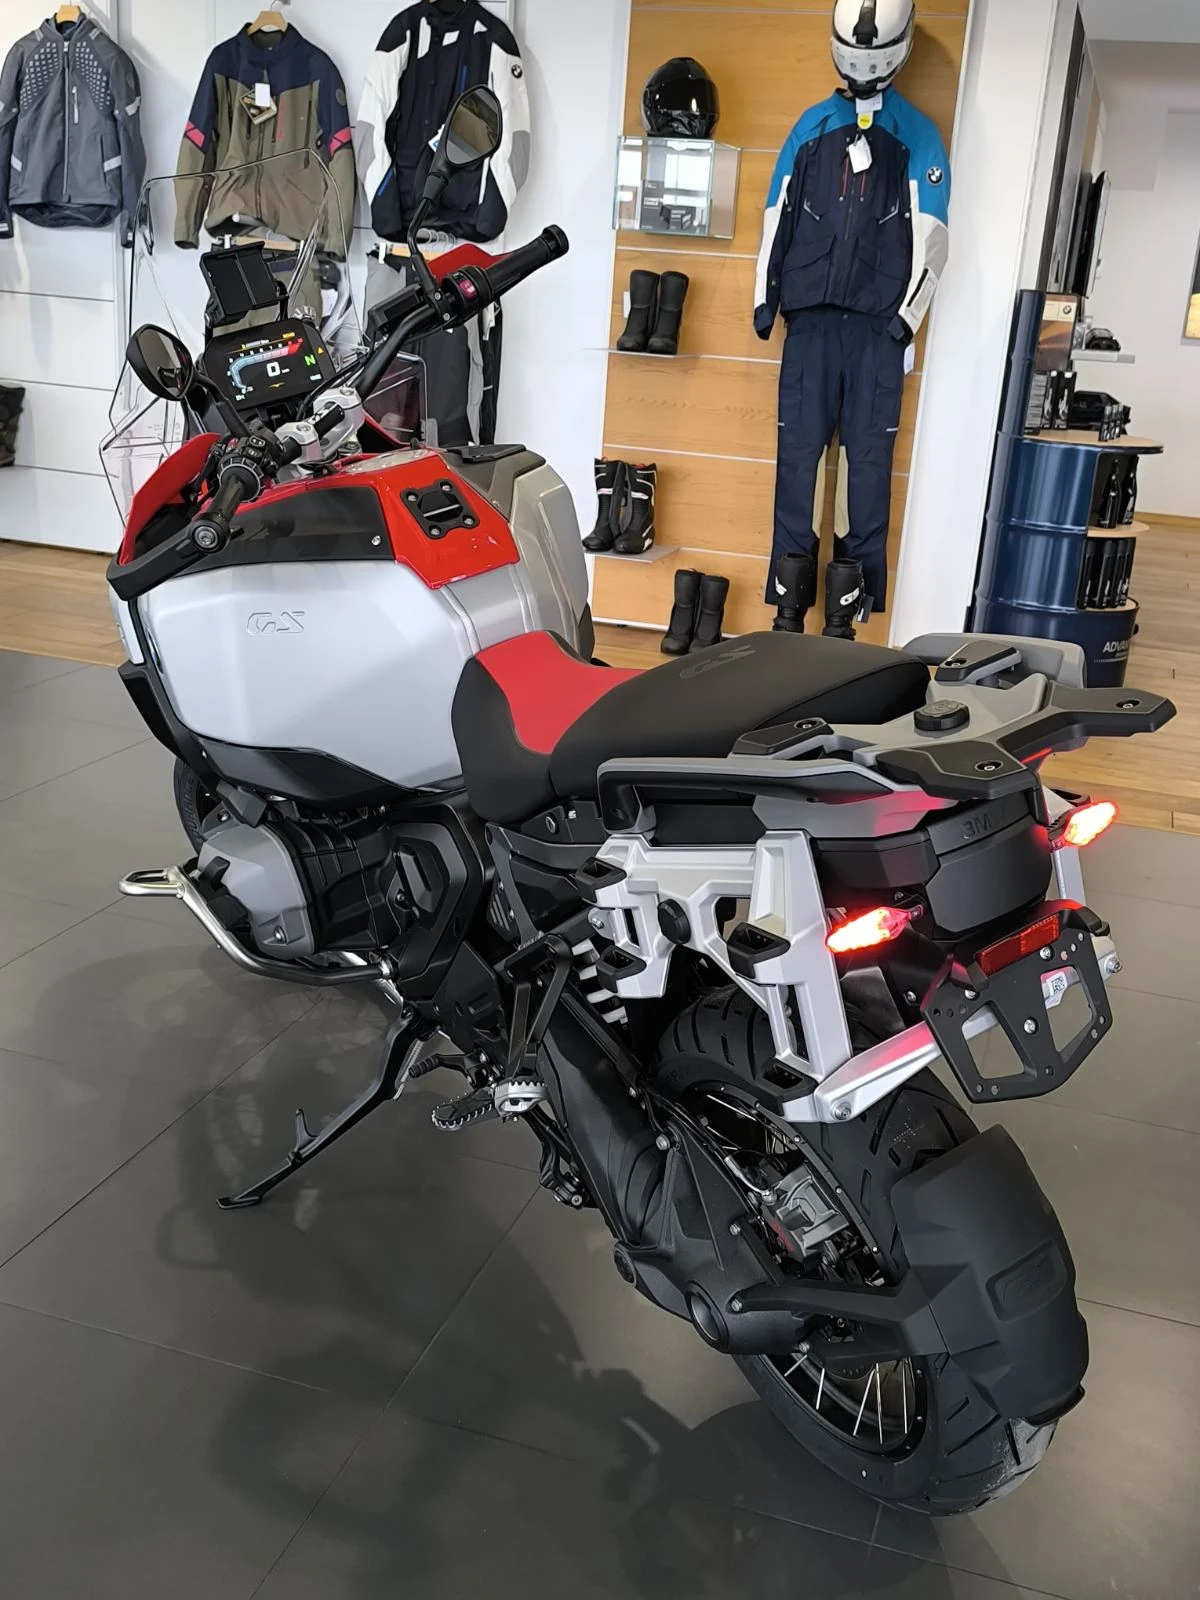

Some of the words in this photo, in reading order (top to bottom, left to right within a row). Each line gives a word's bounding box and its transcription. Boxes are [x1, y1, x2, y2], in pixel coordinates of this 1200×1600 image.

[304, 354, 316, 366] N
[266, 361, 281, 378] 0
[246, 611, 305, 635] GS
